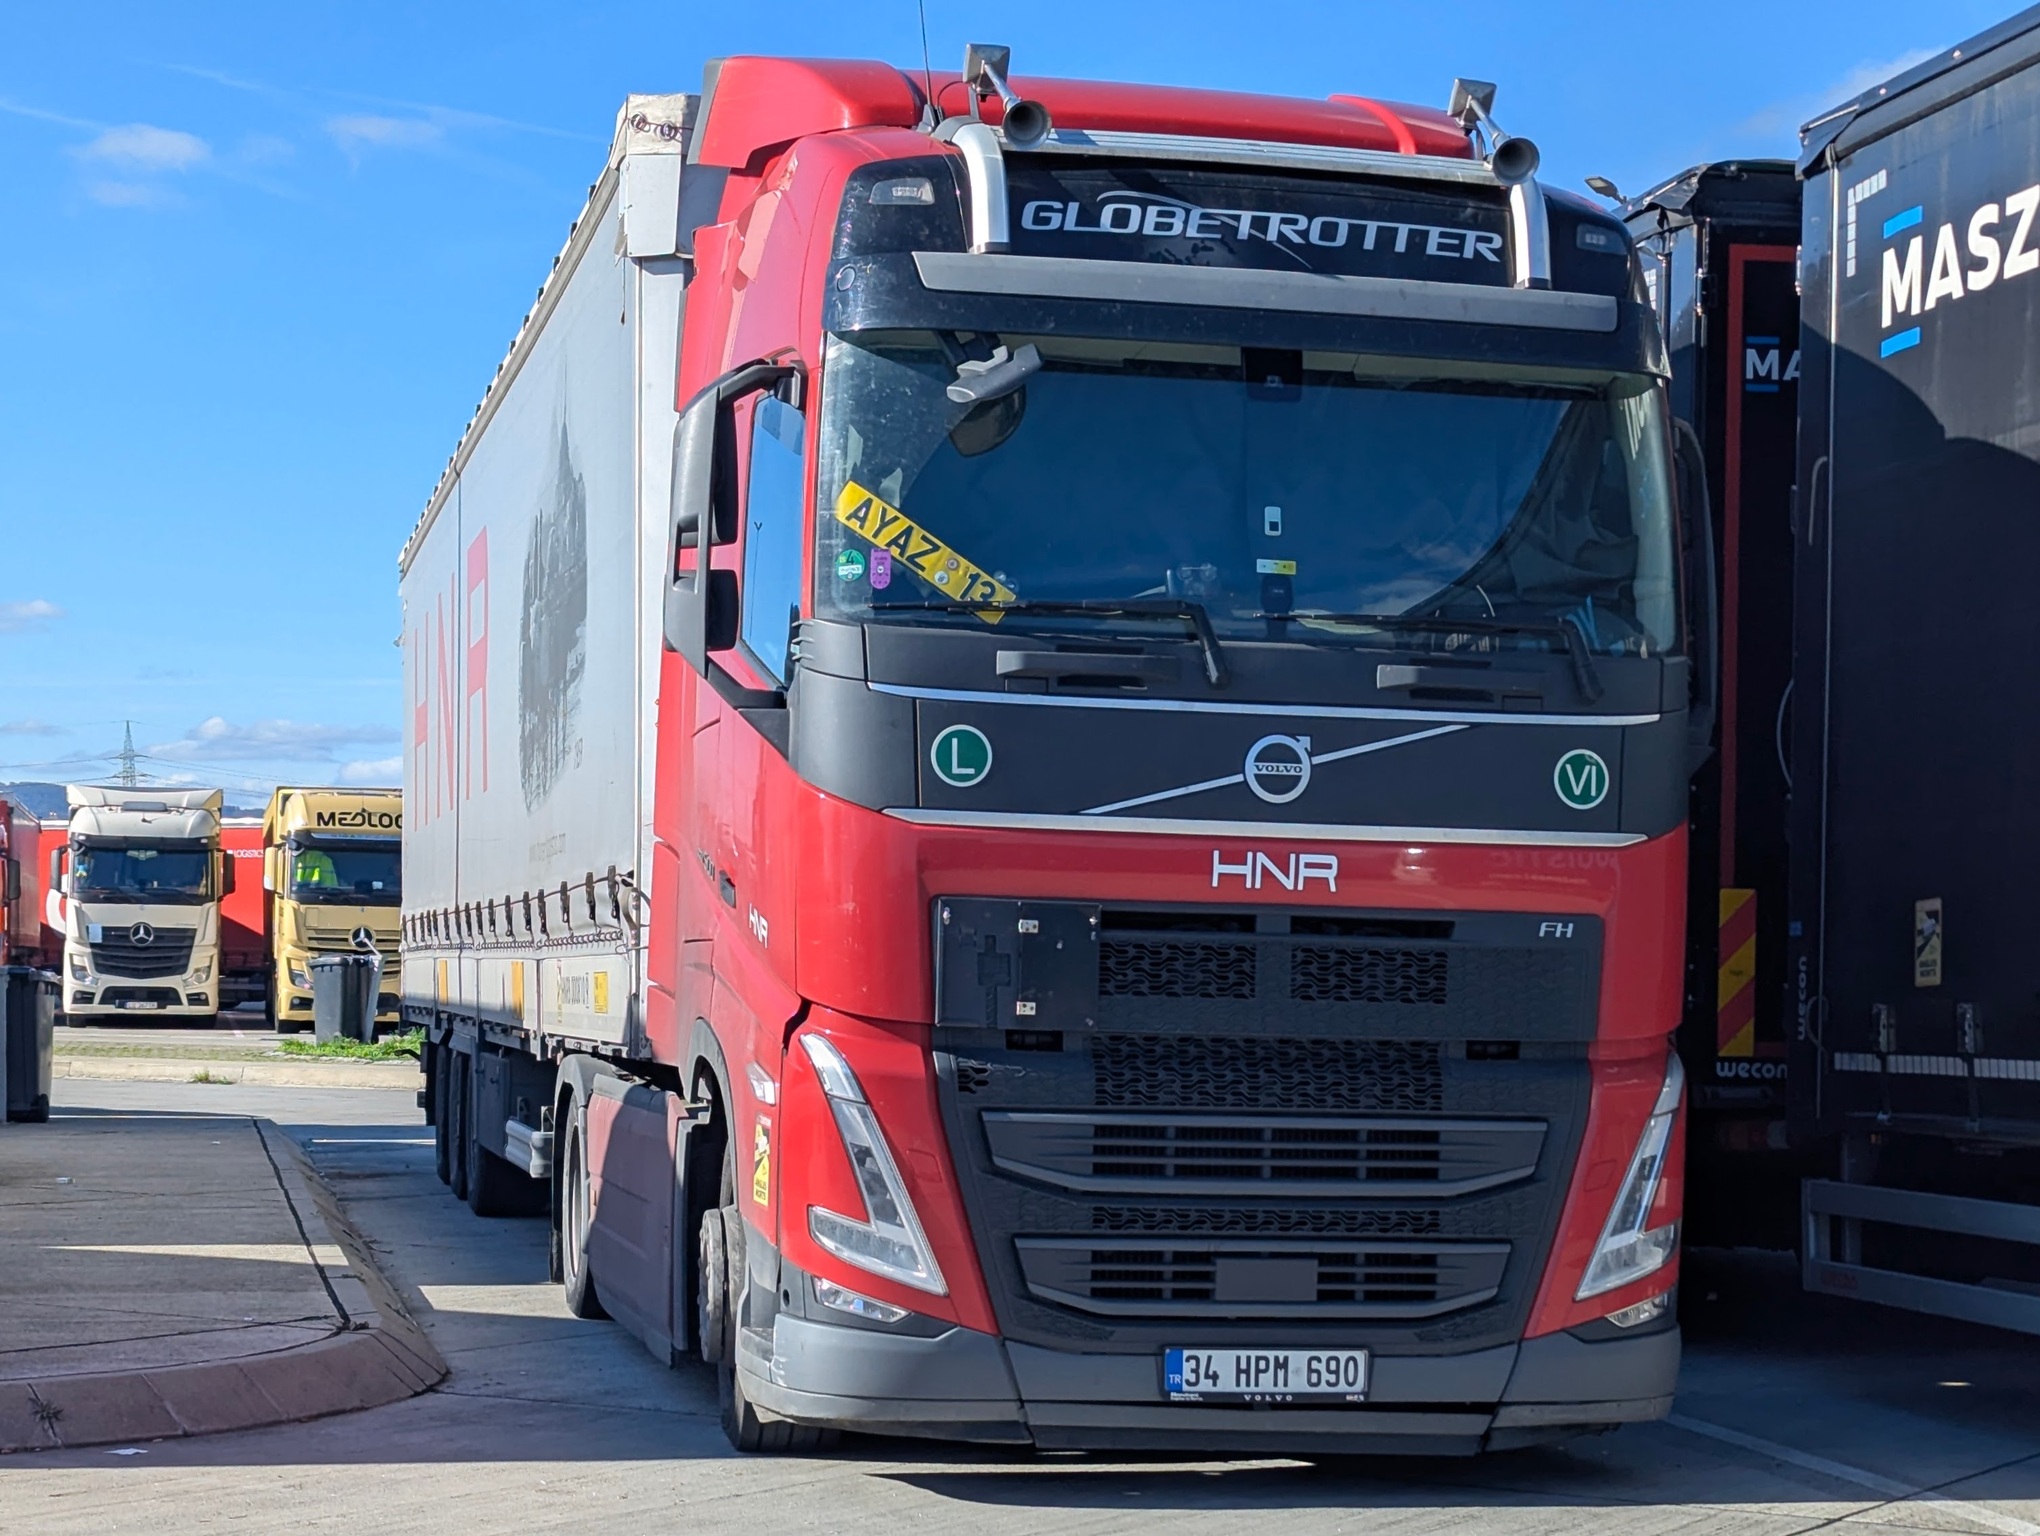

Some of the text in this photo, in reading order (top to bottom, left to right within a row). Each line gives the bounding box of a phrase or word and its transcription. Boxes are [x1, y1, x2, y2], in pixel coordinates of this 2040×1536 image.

[1021, 200, 1503, 263] GLOBETROTTER
[1881, 185, 2040, 328] MASZ
[845, 497, 942, 573] AYAZ
[959, 572, 996, 603] 13
[414, 525, 488, 832] HNR
[951, 737, 976, 774] L
[1254, 764, 1303, 775] VOLVO
[1565, 763, 1597, 797] VI
[1211, 849, 1338, 892] HNR
[748, 902, 768, 949] HNR
[1539, 922, 1574, 938] FH
[1716, 1062, 1788, 1079] wecon
[1169, 1373, 1182, 1385] TR
[1184, 1354, 1359, 1388] 34 HPM 690
[1243, 1394, 1293, 1402] VOLVO
